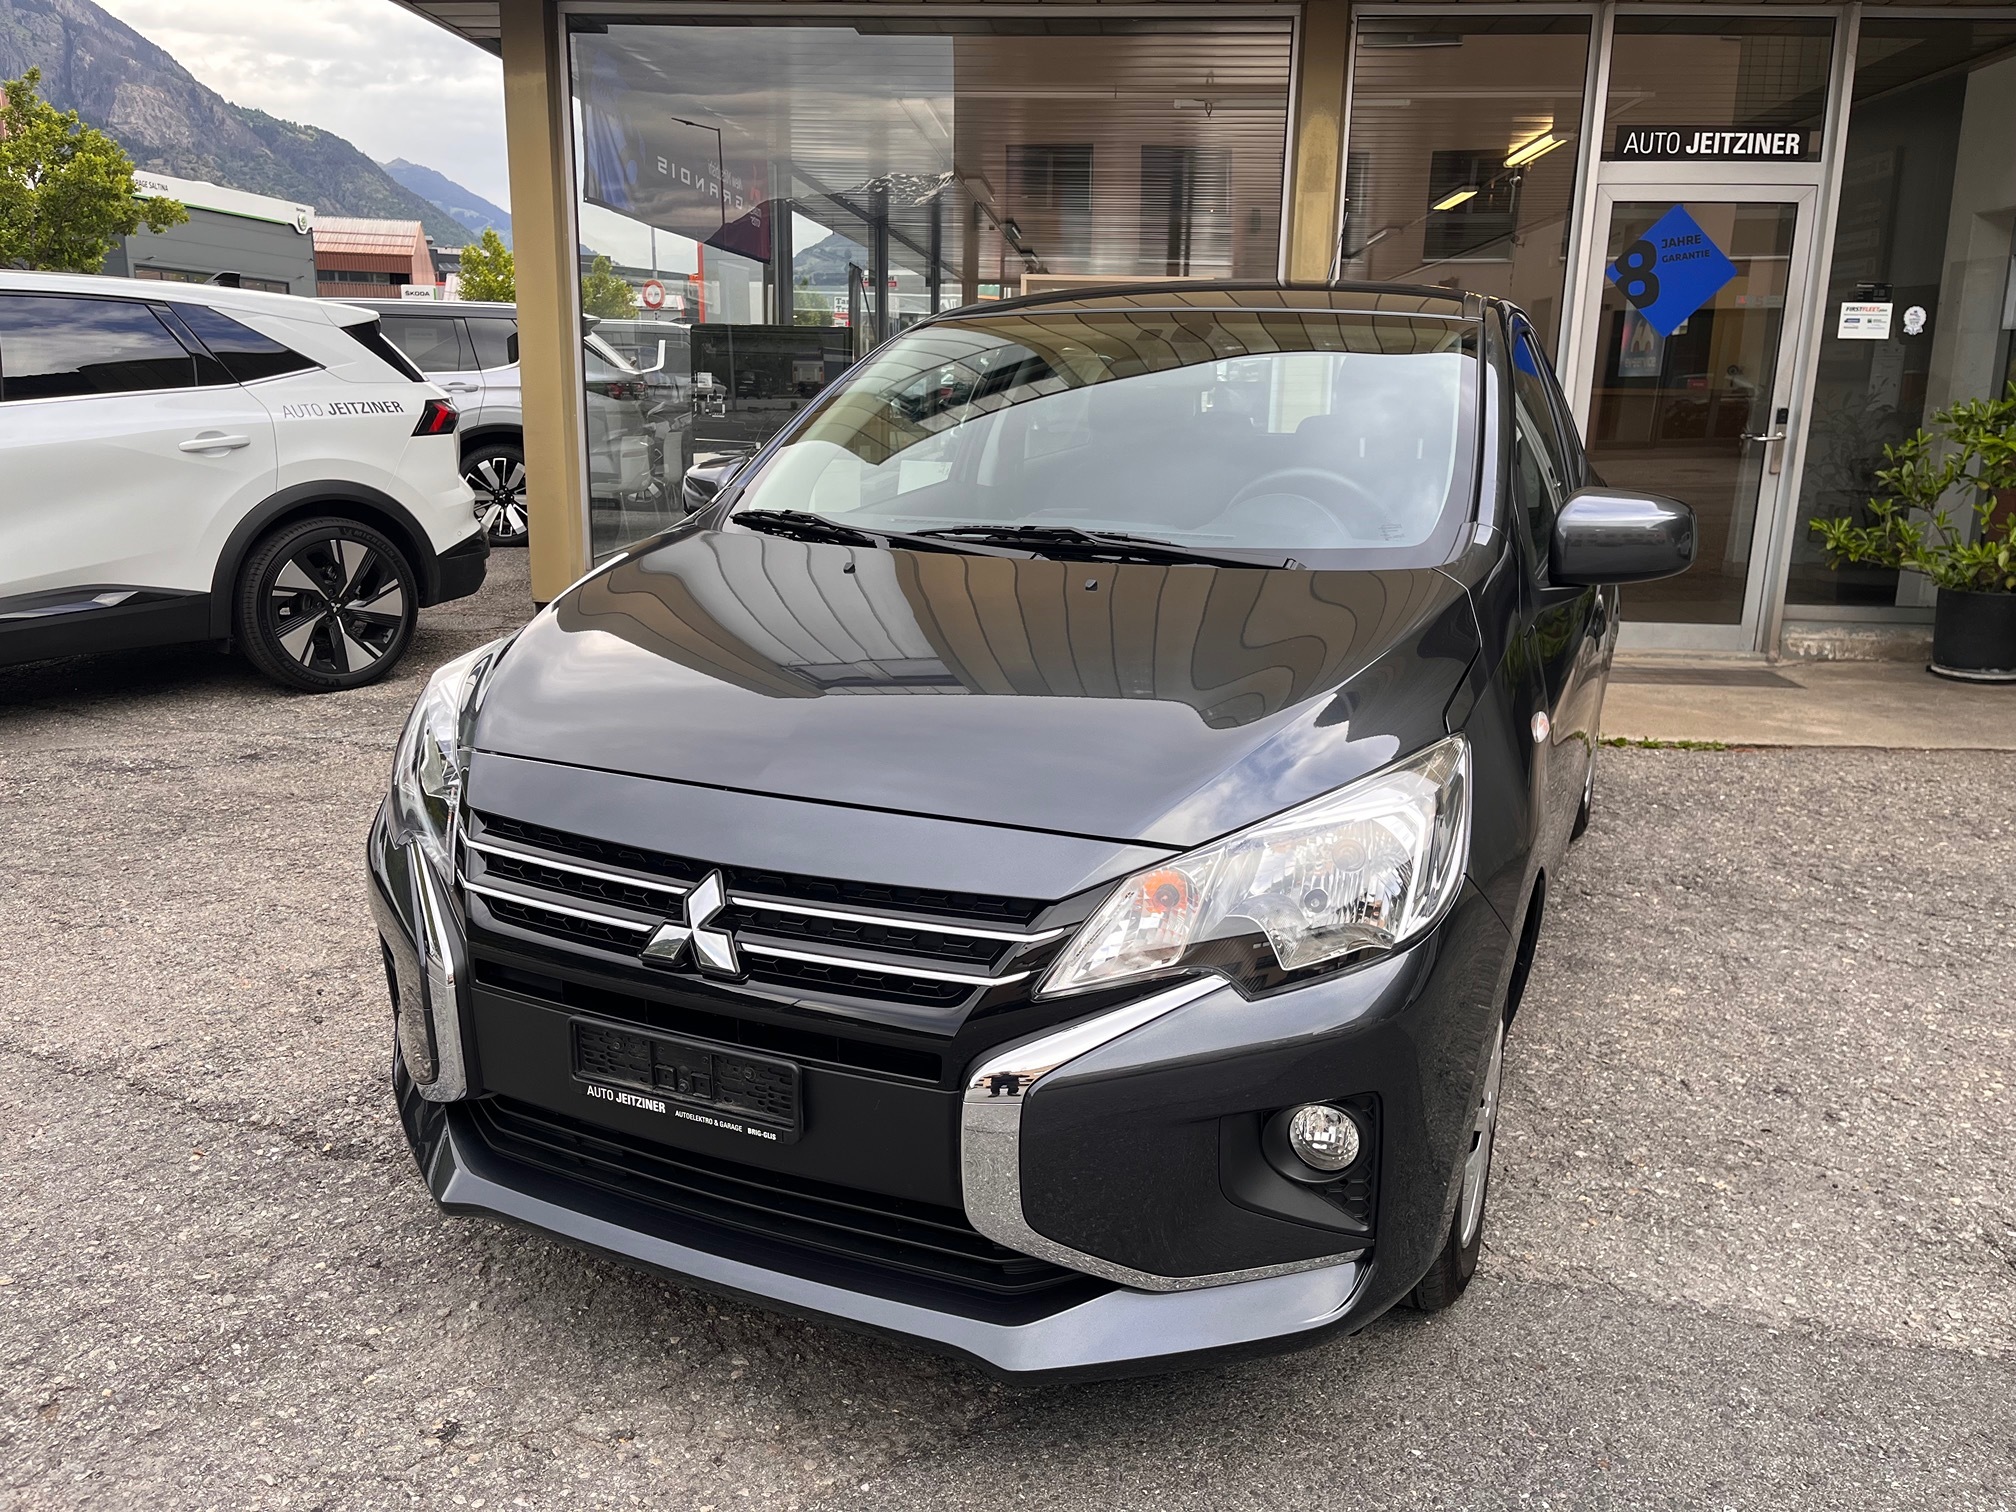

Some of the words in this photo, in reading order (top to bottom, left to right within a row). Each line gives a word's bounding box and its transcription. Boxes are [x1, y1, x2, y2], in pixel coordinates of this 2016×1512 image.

[1623, 131, 1681, 154] AUTO
[1685, 132, 1801, 155] JEITZINER
[1661, 234, 1702, 249] JAHRE
[1661, 249, 1711, 263] GARANTIE
[1614, 239, 1660, 310] 8
[282, 403, 324, 419] AUTO
[328, 401, 404, 416] JEITZINER
[587, 1085, 614, 1101] AUTO
[616, 1092, 666, 1114] JEITZINER
[675, 1110, 713, 1125] AUTOELEKTRO
[714, 1119, 719, 1127] &
[719, 1120, 743, 1132] GARAGE
[747, 1127, 777, 1141] BRIG-GLIS
